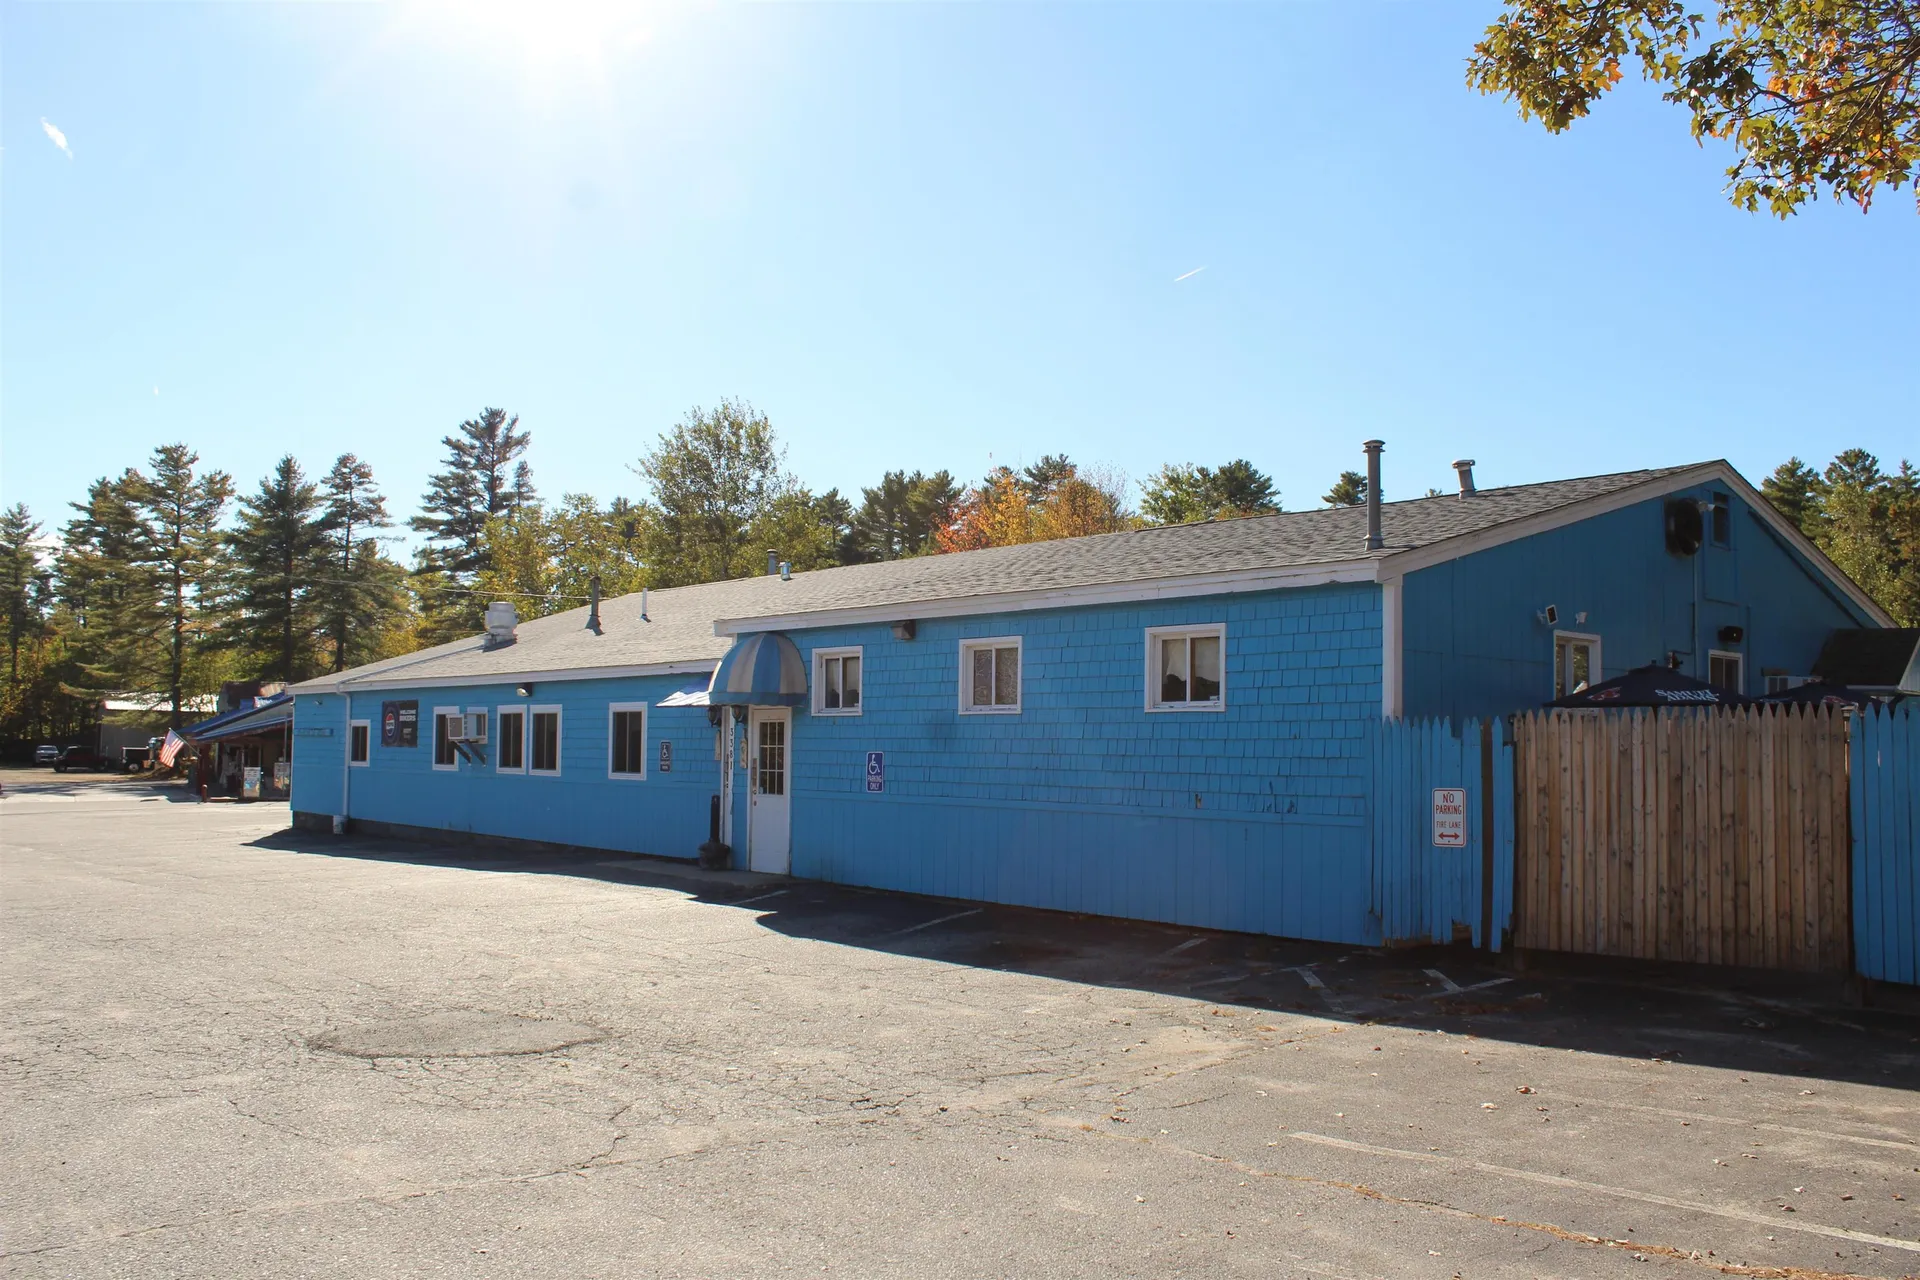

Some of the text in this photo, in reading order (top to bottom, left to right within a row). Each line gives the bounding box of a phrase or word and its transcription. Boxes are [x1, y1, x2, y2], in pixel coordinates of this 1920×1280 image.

[1442, 793, 1455, 803] NO
[1435, 804, 1462, 815] PARKING
[1436, 820, 1462, 829] FIRE LANE
